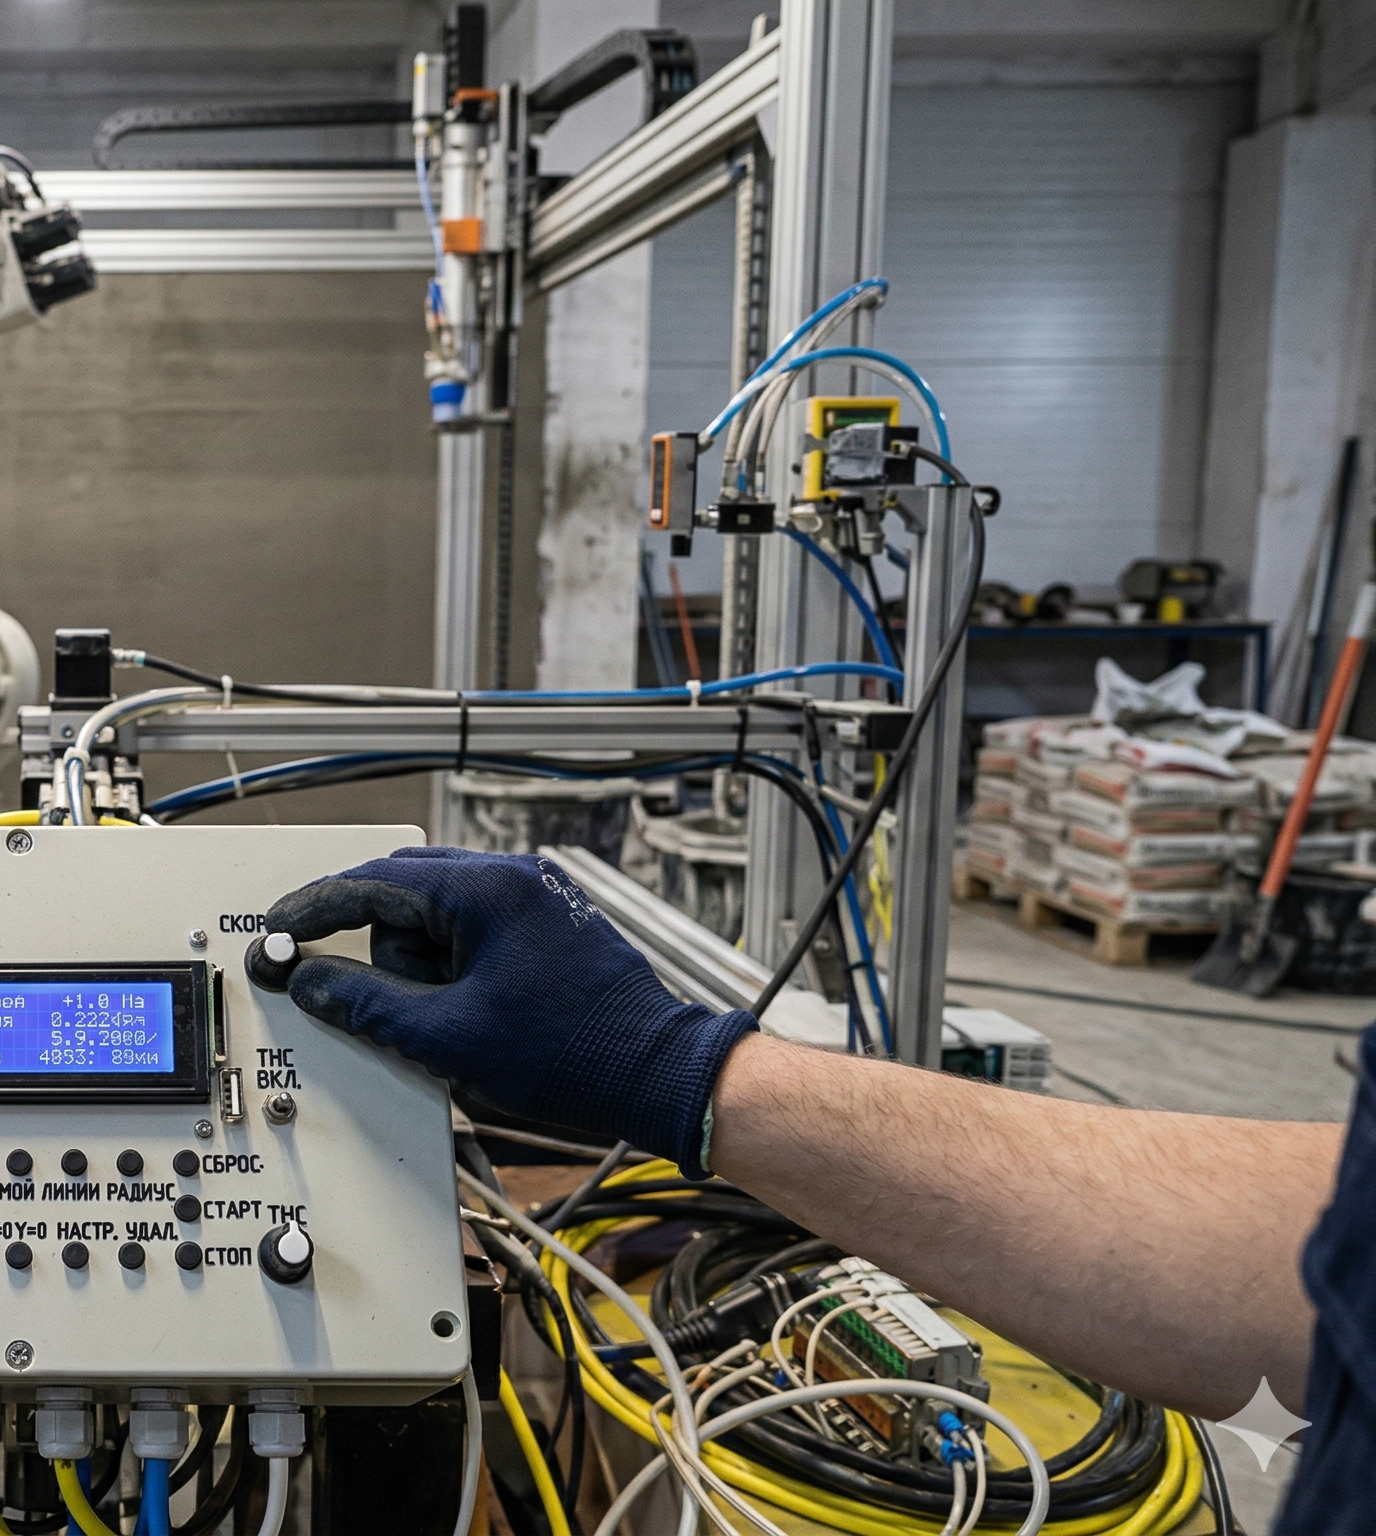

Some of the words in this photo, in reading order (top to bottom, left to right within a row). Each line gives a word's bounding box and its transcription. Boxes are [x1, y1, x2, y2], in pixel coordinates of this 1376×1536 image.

[256, 1048, 294, 1068] ТНС
[256, 1069, 302, 1090] ВКЛ.
[41, 1182, 100, 1202] ЛИНИИ
[107, 1182, 176, 1202] РАДИУС
[203, 1200, 262, 1219] СТАРТ
[267, 1204, 308, 1225] ТНС
[57, 1221, 118, 1240] НАСТР.
[126, 1221, 179, 1242] УДАЛ.
[204, 1247, 252, 1266] СТОП
